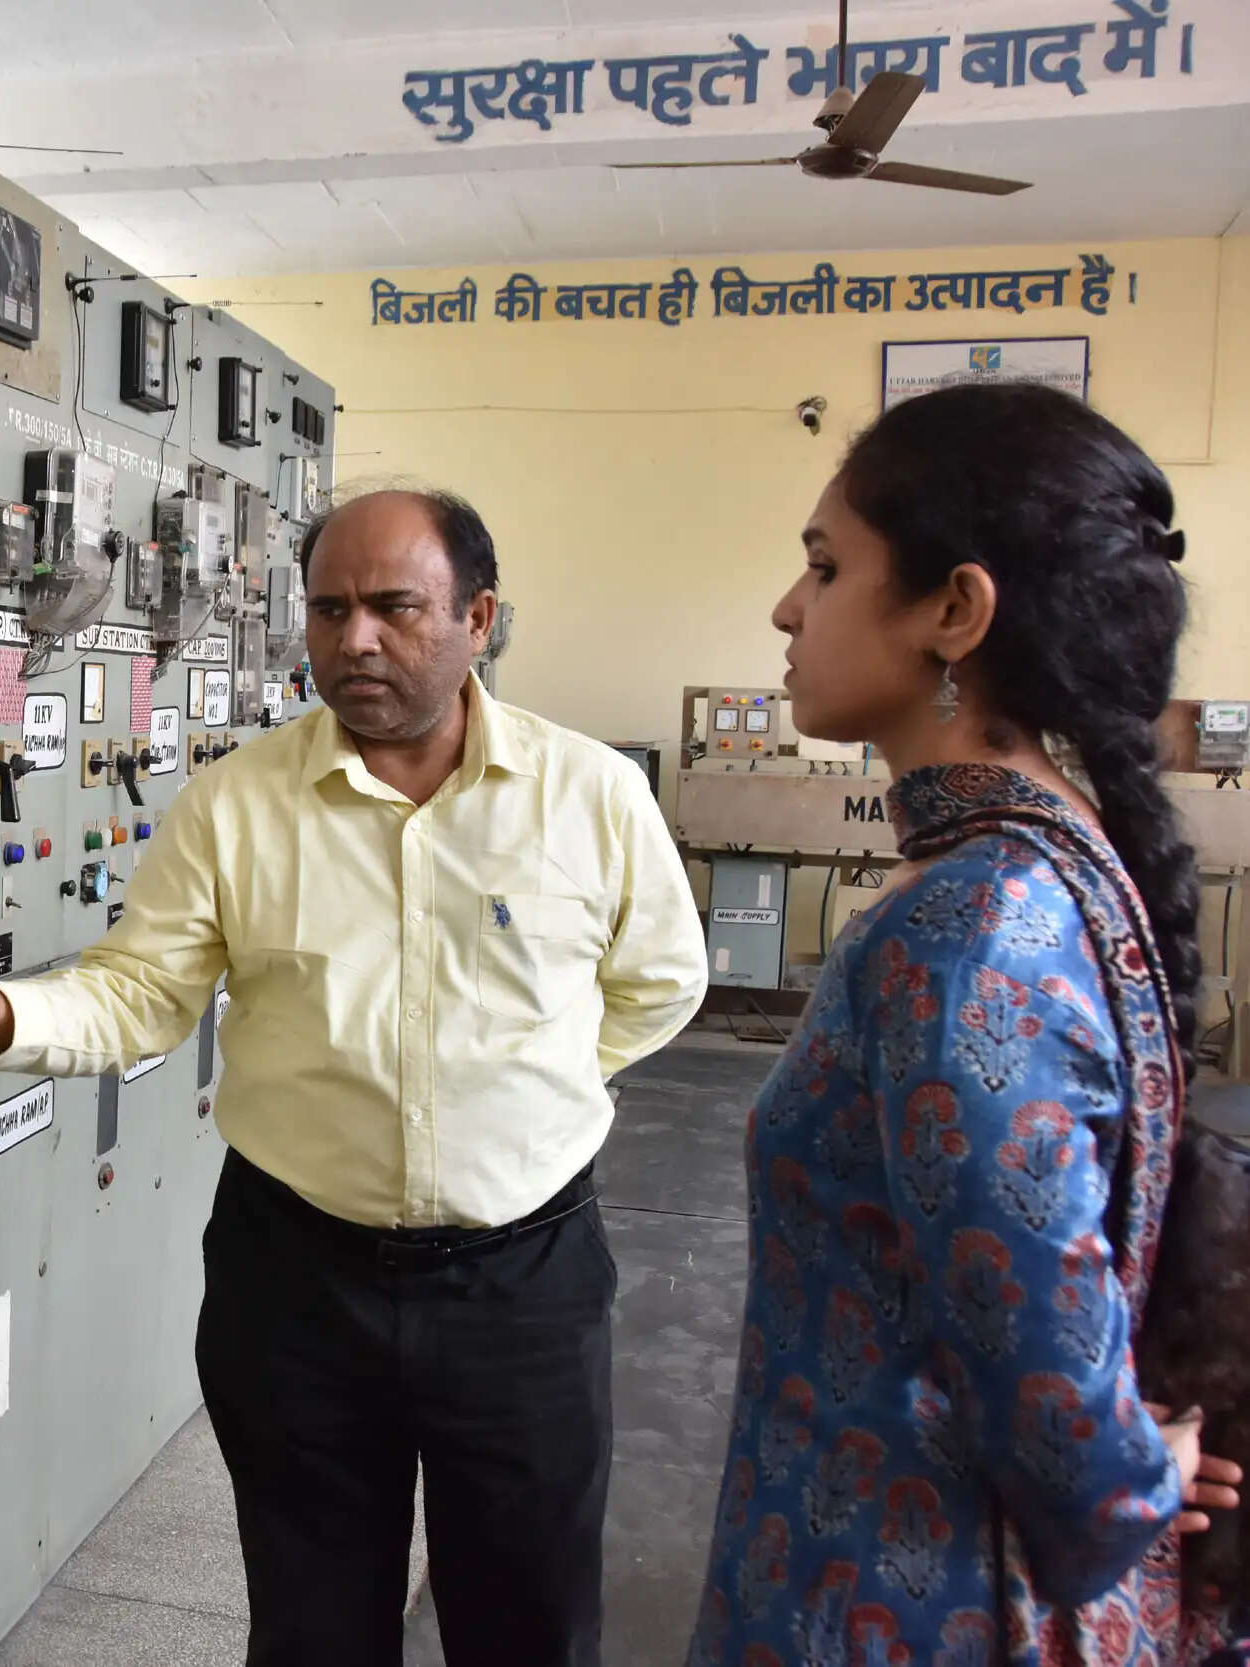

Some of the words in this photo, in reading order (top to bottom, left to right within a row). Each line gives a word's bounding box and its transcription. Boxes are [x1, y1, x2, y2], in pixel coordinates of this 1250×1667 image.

[402, 58, 595, 142] सुरक्षा
[961, 22, 1096, 97] बाद
[370, 277, 478, 326] बिजली
[495, 272, 548, 322] की
[554, 282, 653, 320] बचत
[658, 267, 699, 326] ही
[710, 262, 841, 317] बिजली
[844, 275, 897, 314] का
[905, 268, 1072, 315] उत्पादन
[103, 630, 139, 648] STATION
[34, 704, 53, 724] 11KV
[843, 795, 894, 823] MA
